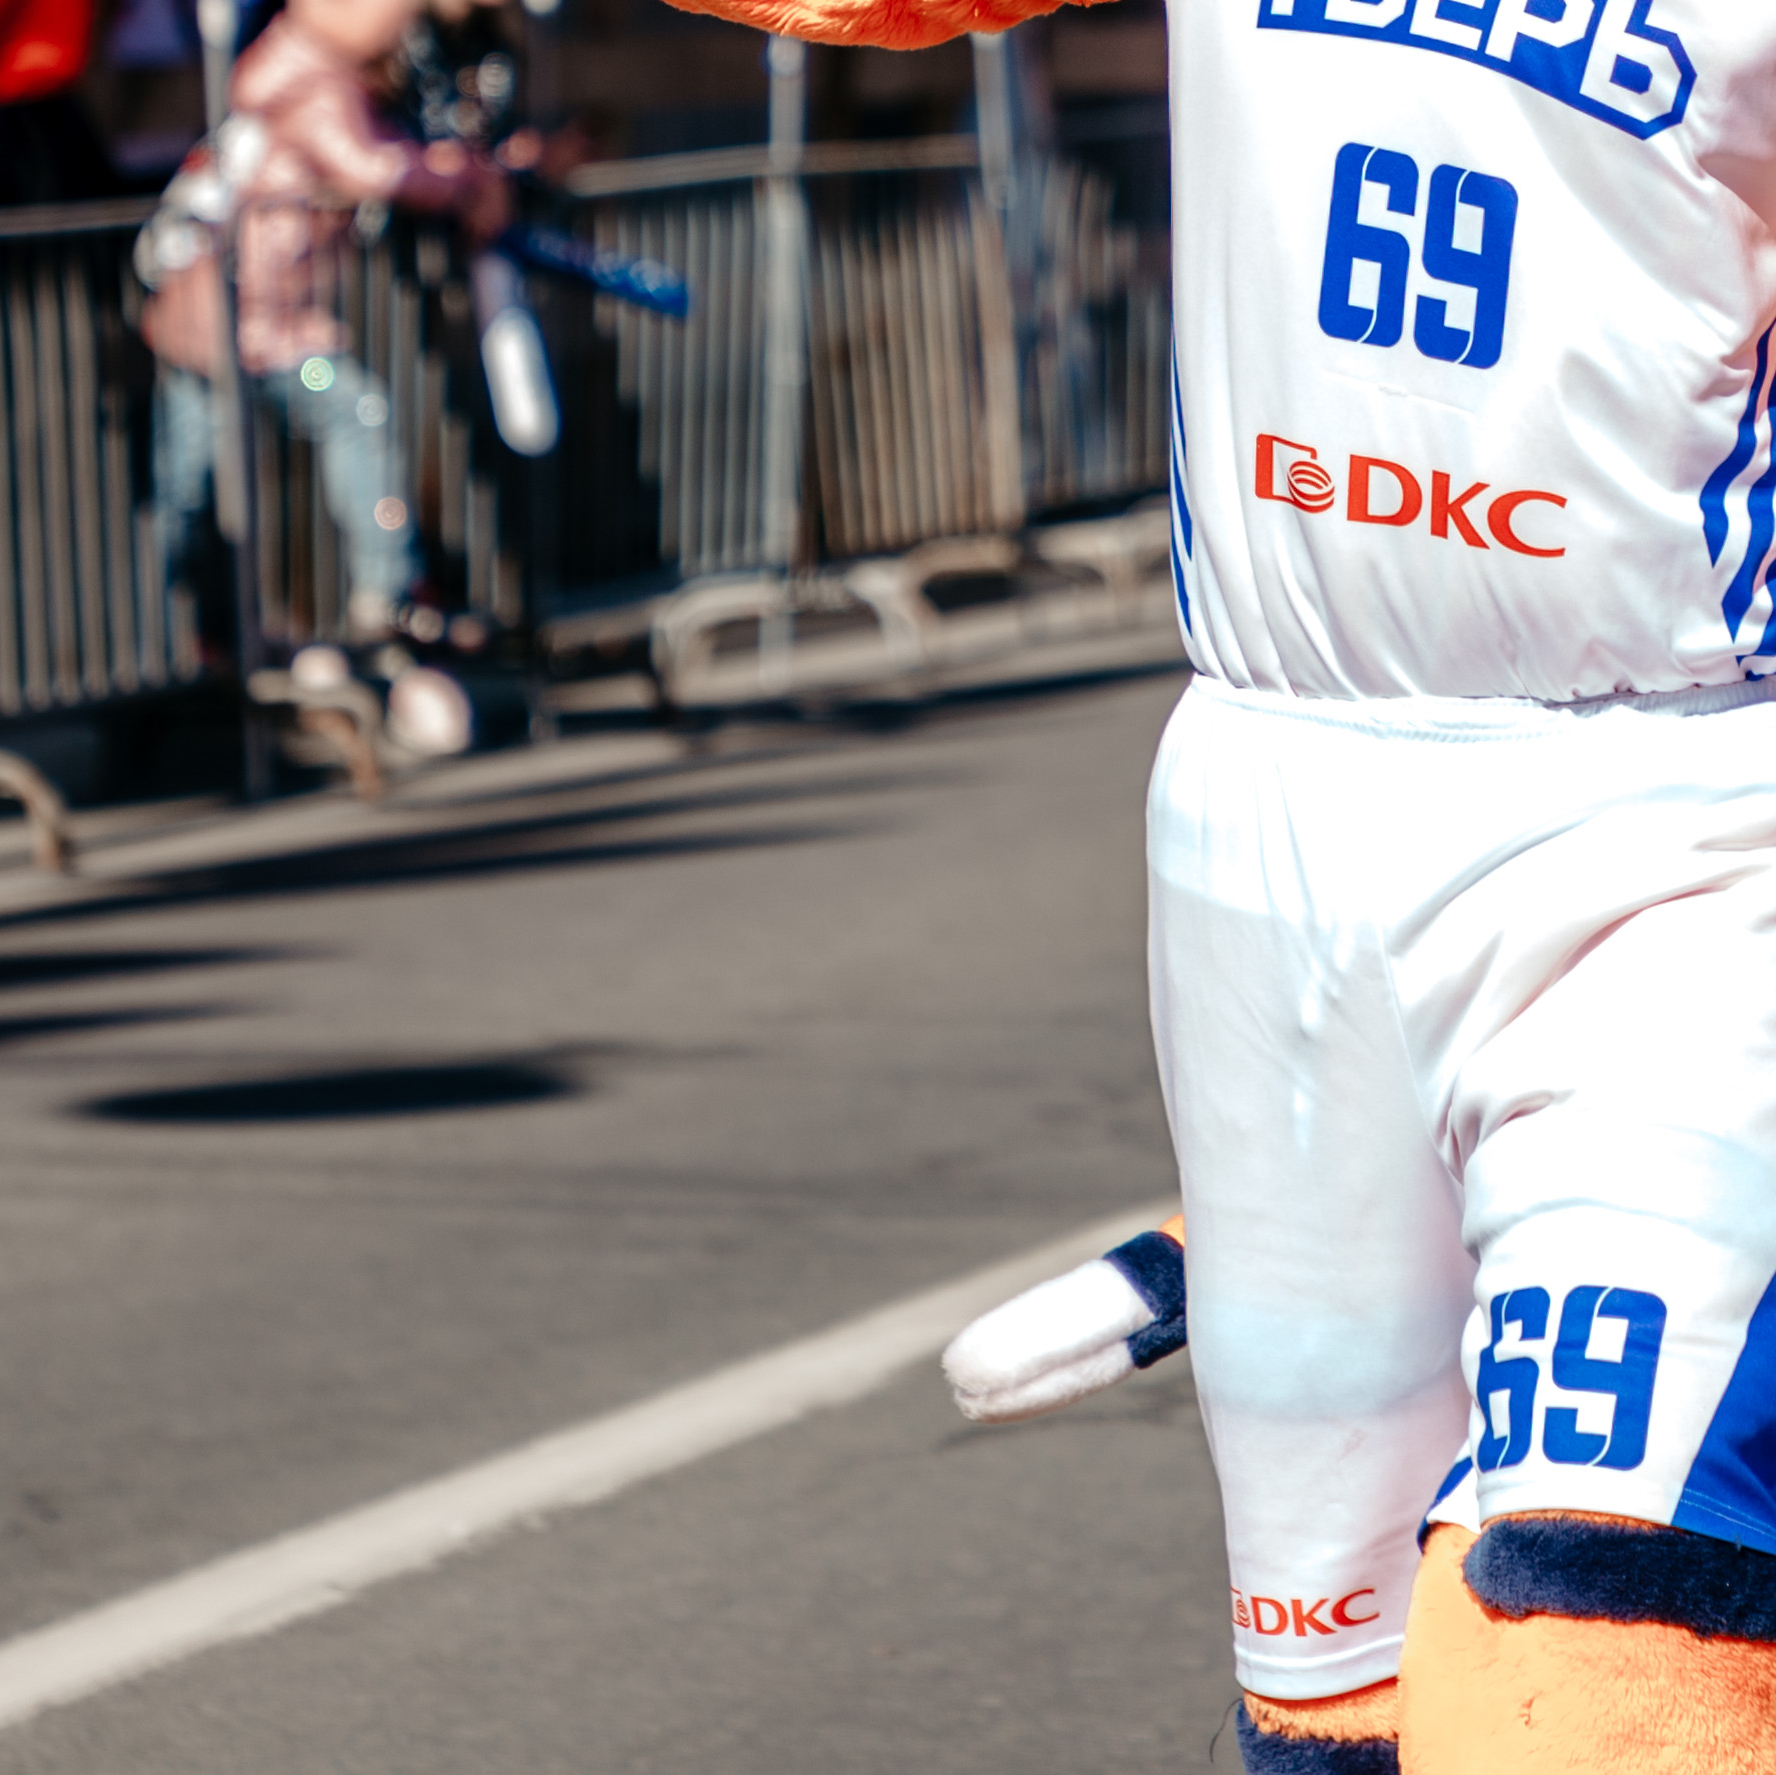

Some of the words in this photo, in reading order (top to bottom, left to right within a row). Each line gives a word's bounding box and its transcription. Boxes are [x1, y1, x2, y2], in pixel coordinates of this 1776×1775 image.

[1317, 141, 1519, 370] 69
[1346, 454, 1568, 559] DKC
[1476, 1284, 1668, 1472] 69
[1249, 1588, 1381, 1637] DKC
